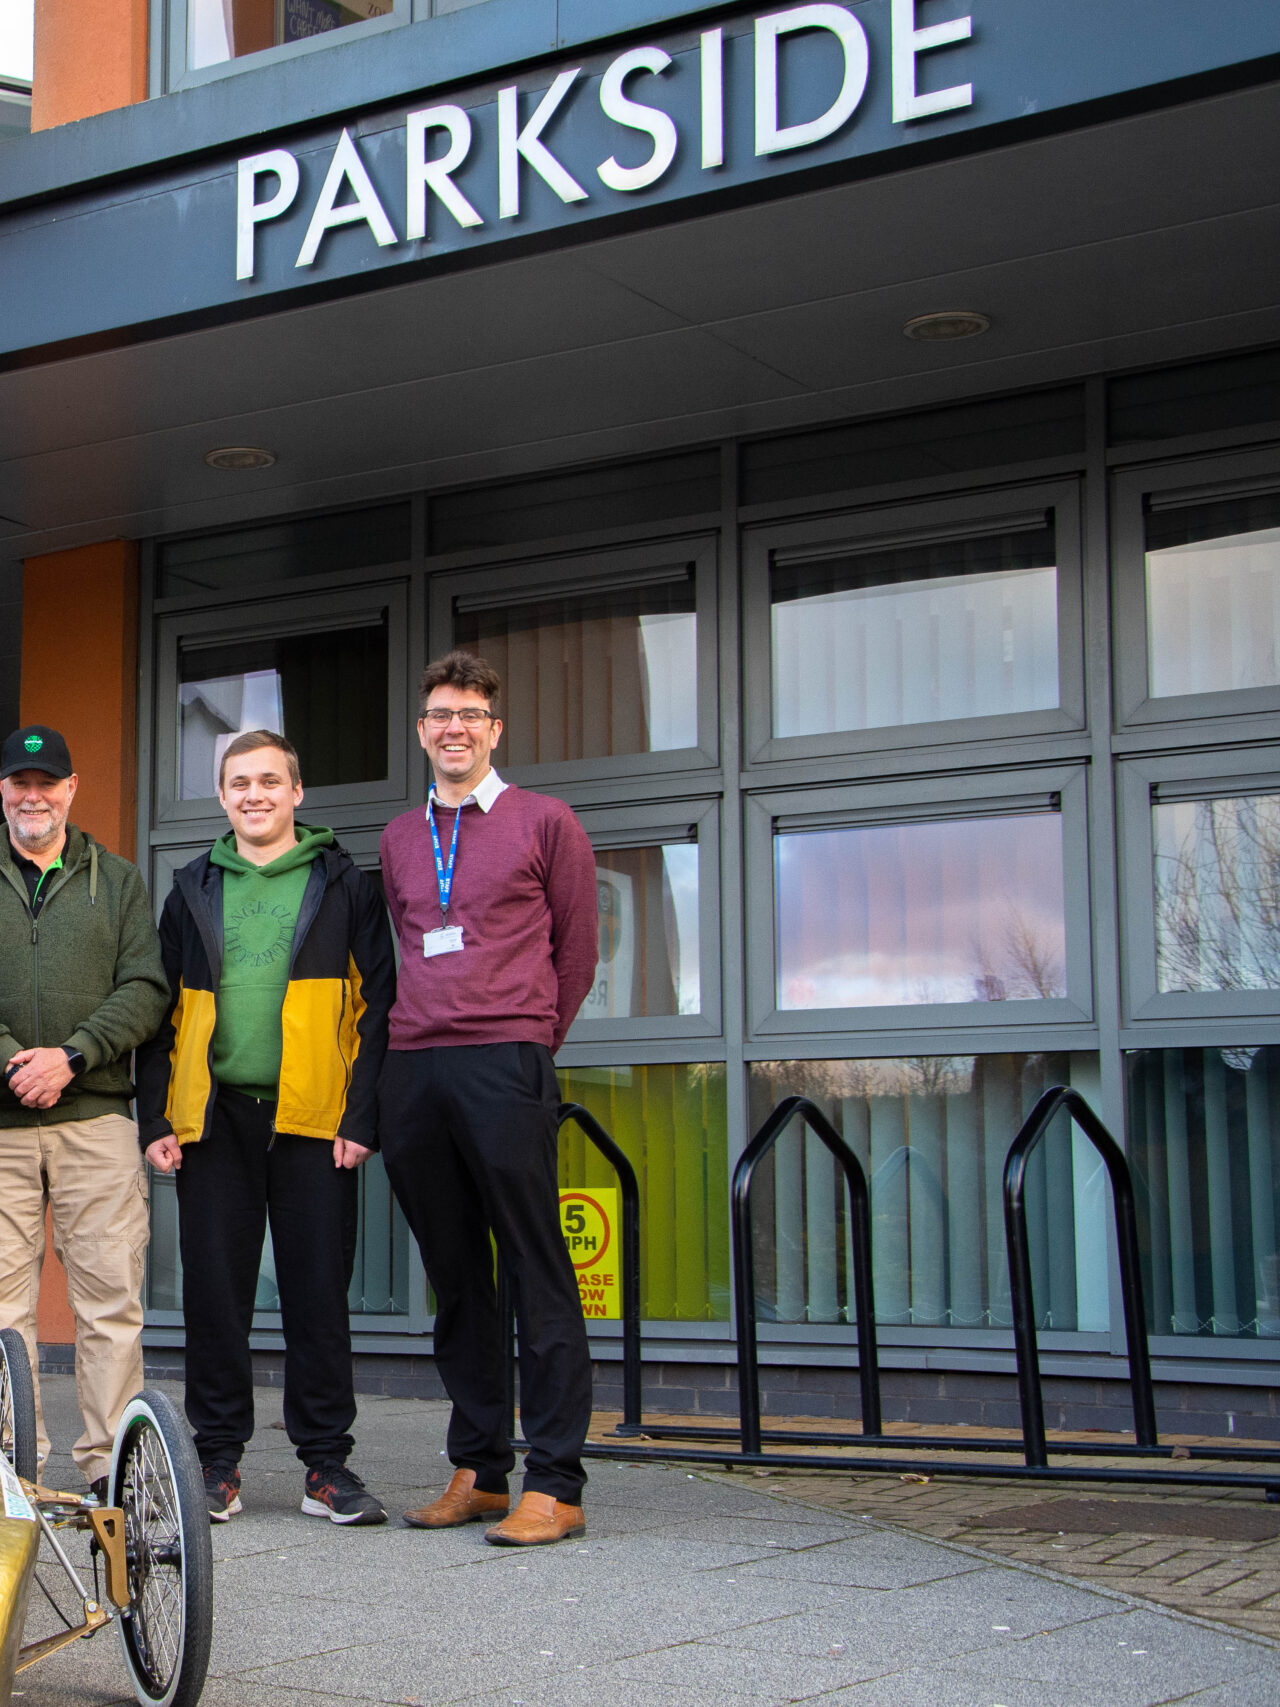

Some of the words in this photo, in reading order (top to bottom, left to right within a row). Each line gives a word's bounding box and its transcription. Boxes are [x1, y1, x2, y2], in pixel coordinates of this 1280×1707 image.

[236, 0, 974, 281] PARKSIDE
[565, 1204, 586, 1234] 5
[577, 1274, 614, 1286] ASE
